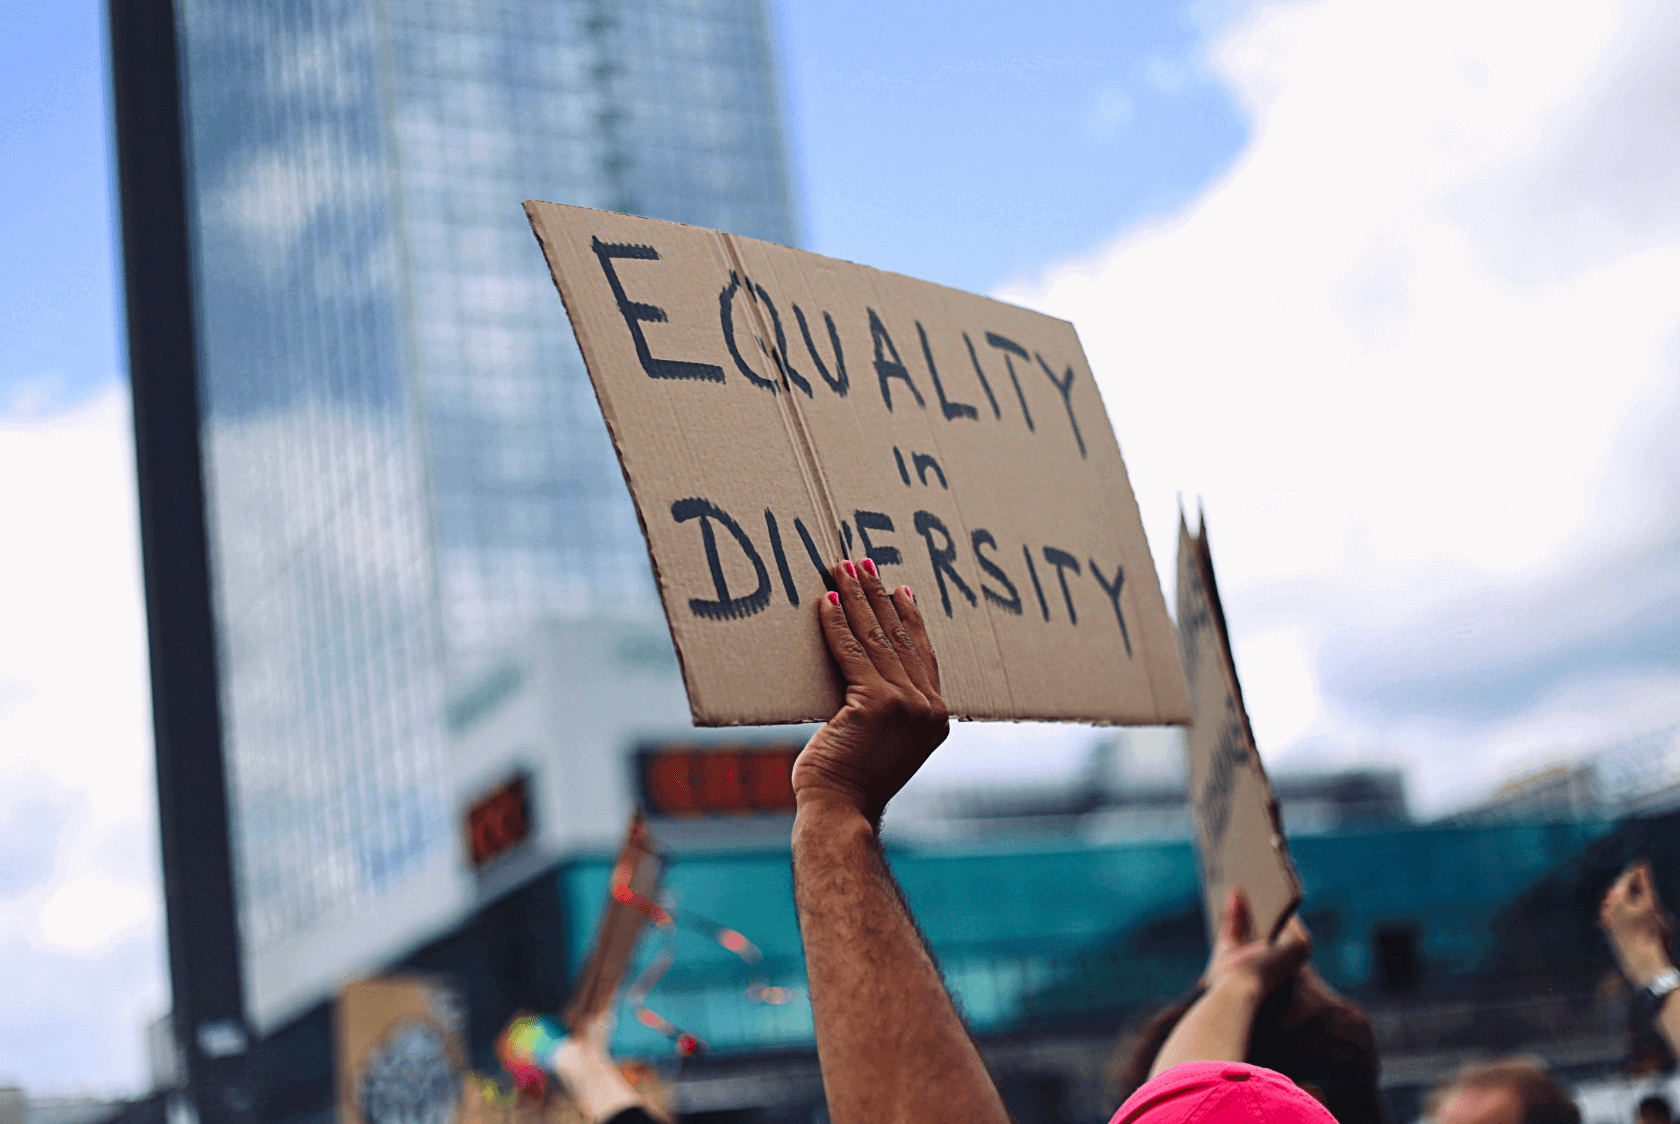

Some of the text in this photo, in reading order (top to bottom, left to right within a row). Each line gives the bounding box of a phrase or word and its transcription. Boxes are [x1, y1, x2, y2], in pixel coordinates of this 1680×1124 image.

[591, 235, 1087, 460] EQUALITY
[892, 445, 949, 491] in
[670, 497, 1132, 658] DIVERSITY
